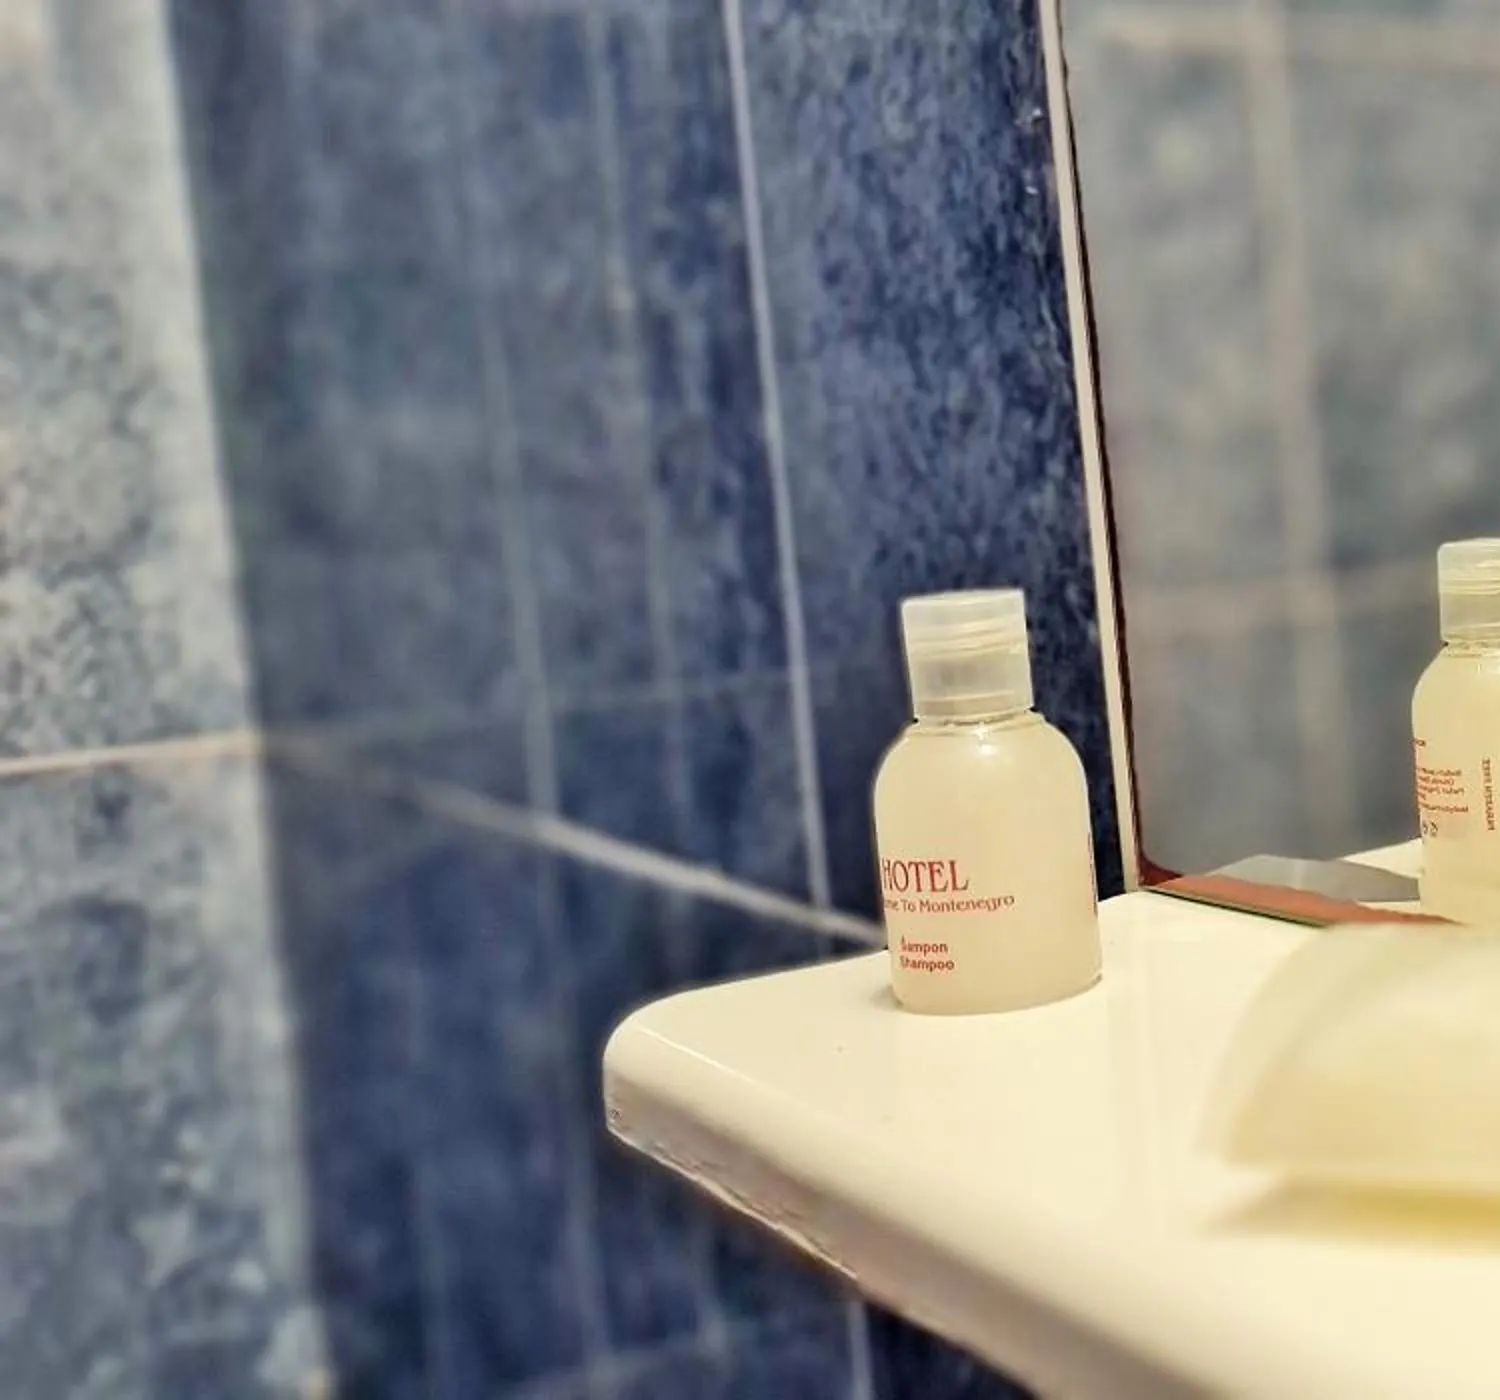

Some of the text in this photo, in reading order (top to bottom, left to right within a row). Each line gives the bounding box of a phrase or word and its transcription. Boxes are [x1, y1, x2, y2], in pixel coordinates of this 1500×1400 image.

[881, 857, 970, 893] HOTEL
[901, 899, 916, 913] To
[919, 895, 1015, 913] Montenegro
